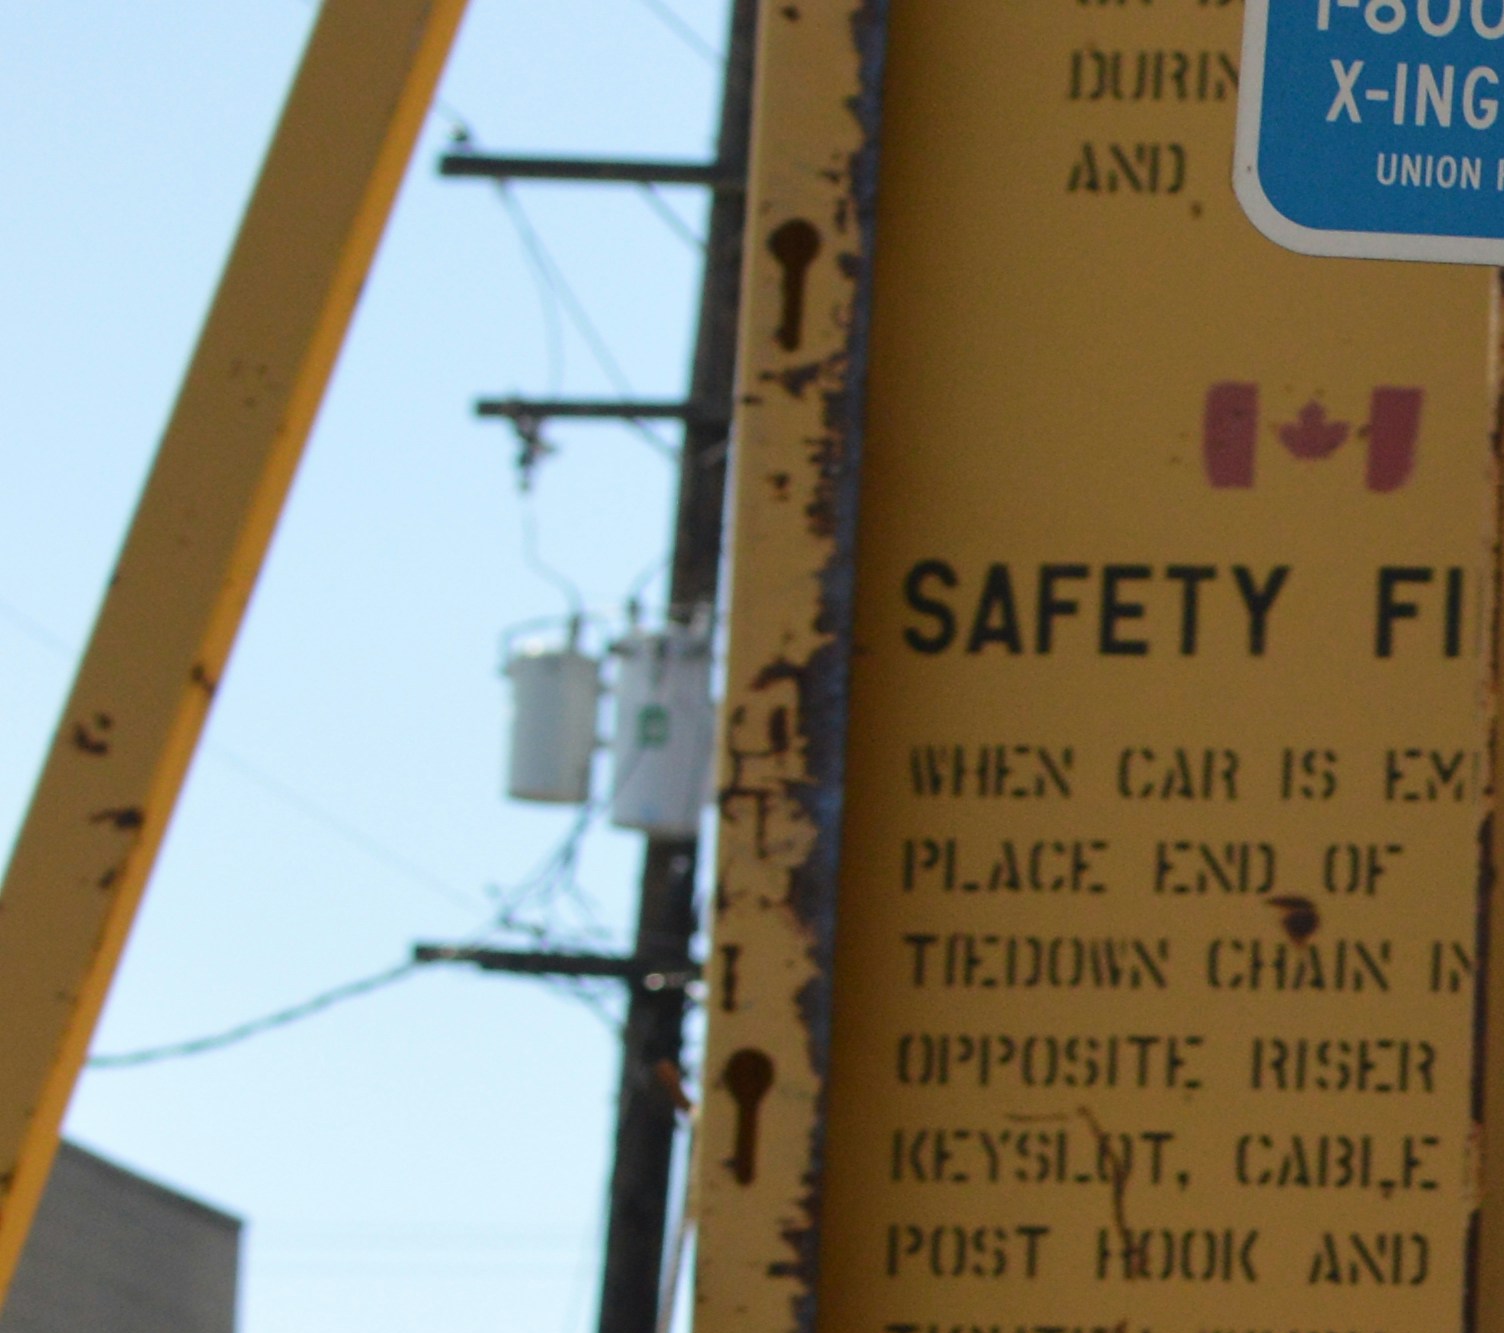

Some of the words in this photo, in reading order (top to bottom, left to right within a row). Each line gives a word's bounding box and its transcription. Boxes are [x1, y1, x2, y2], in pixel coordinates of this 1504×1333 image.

[1325, 59, 1499, 130] X-ING
[1067, 142, 1186, 195] AND
[1376, 152, 1482, 190] UNION
[896, 557, 1289, 658] SAFETY
[1375, 566, 1464, 659] FI
[904, 743, 1073, 799] WHEN
[1117, 747, 1239, 801] CAR
[1281, 748, 1337, 800] IS
[897, 835, 1107, 897] PLACE
[1153, 840, 1276, 895] END
[1323, 844, 1403, 896] OF
[899, 929, 1168, 990] TIEDOWN
[1207, 935, 1391, 992] CHAIN
[1430, 941, 1477, 995] IN
[892, 1029, 1204, 1093] OPPOSITE
[1251, 1038, 1436, 1094] RISER
[1235, 1134, 1440, 1193] CABLE
[881, 1221, 1050, 1281] POST
[1096, 1223, 1259, 1283] HOOK
[1308, 1232, 1430, 1287] AND
